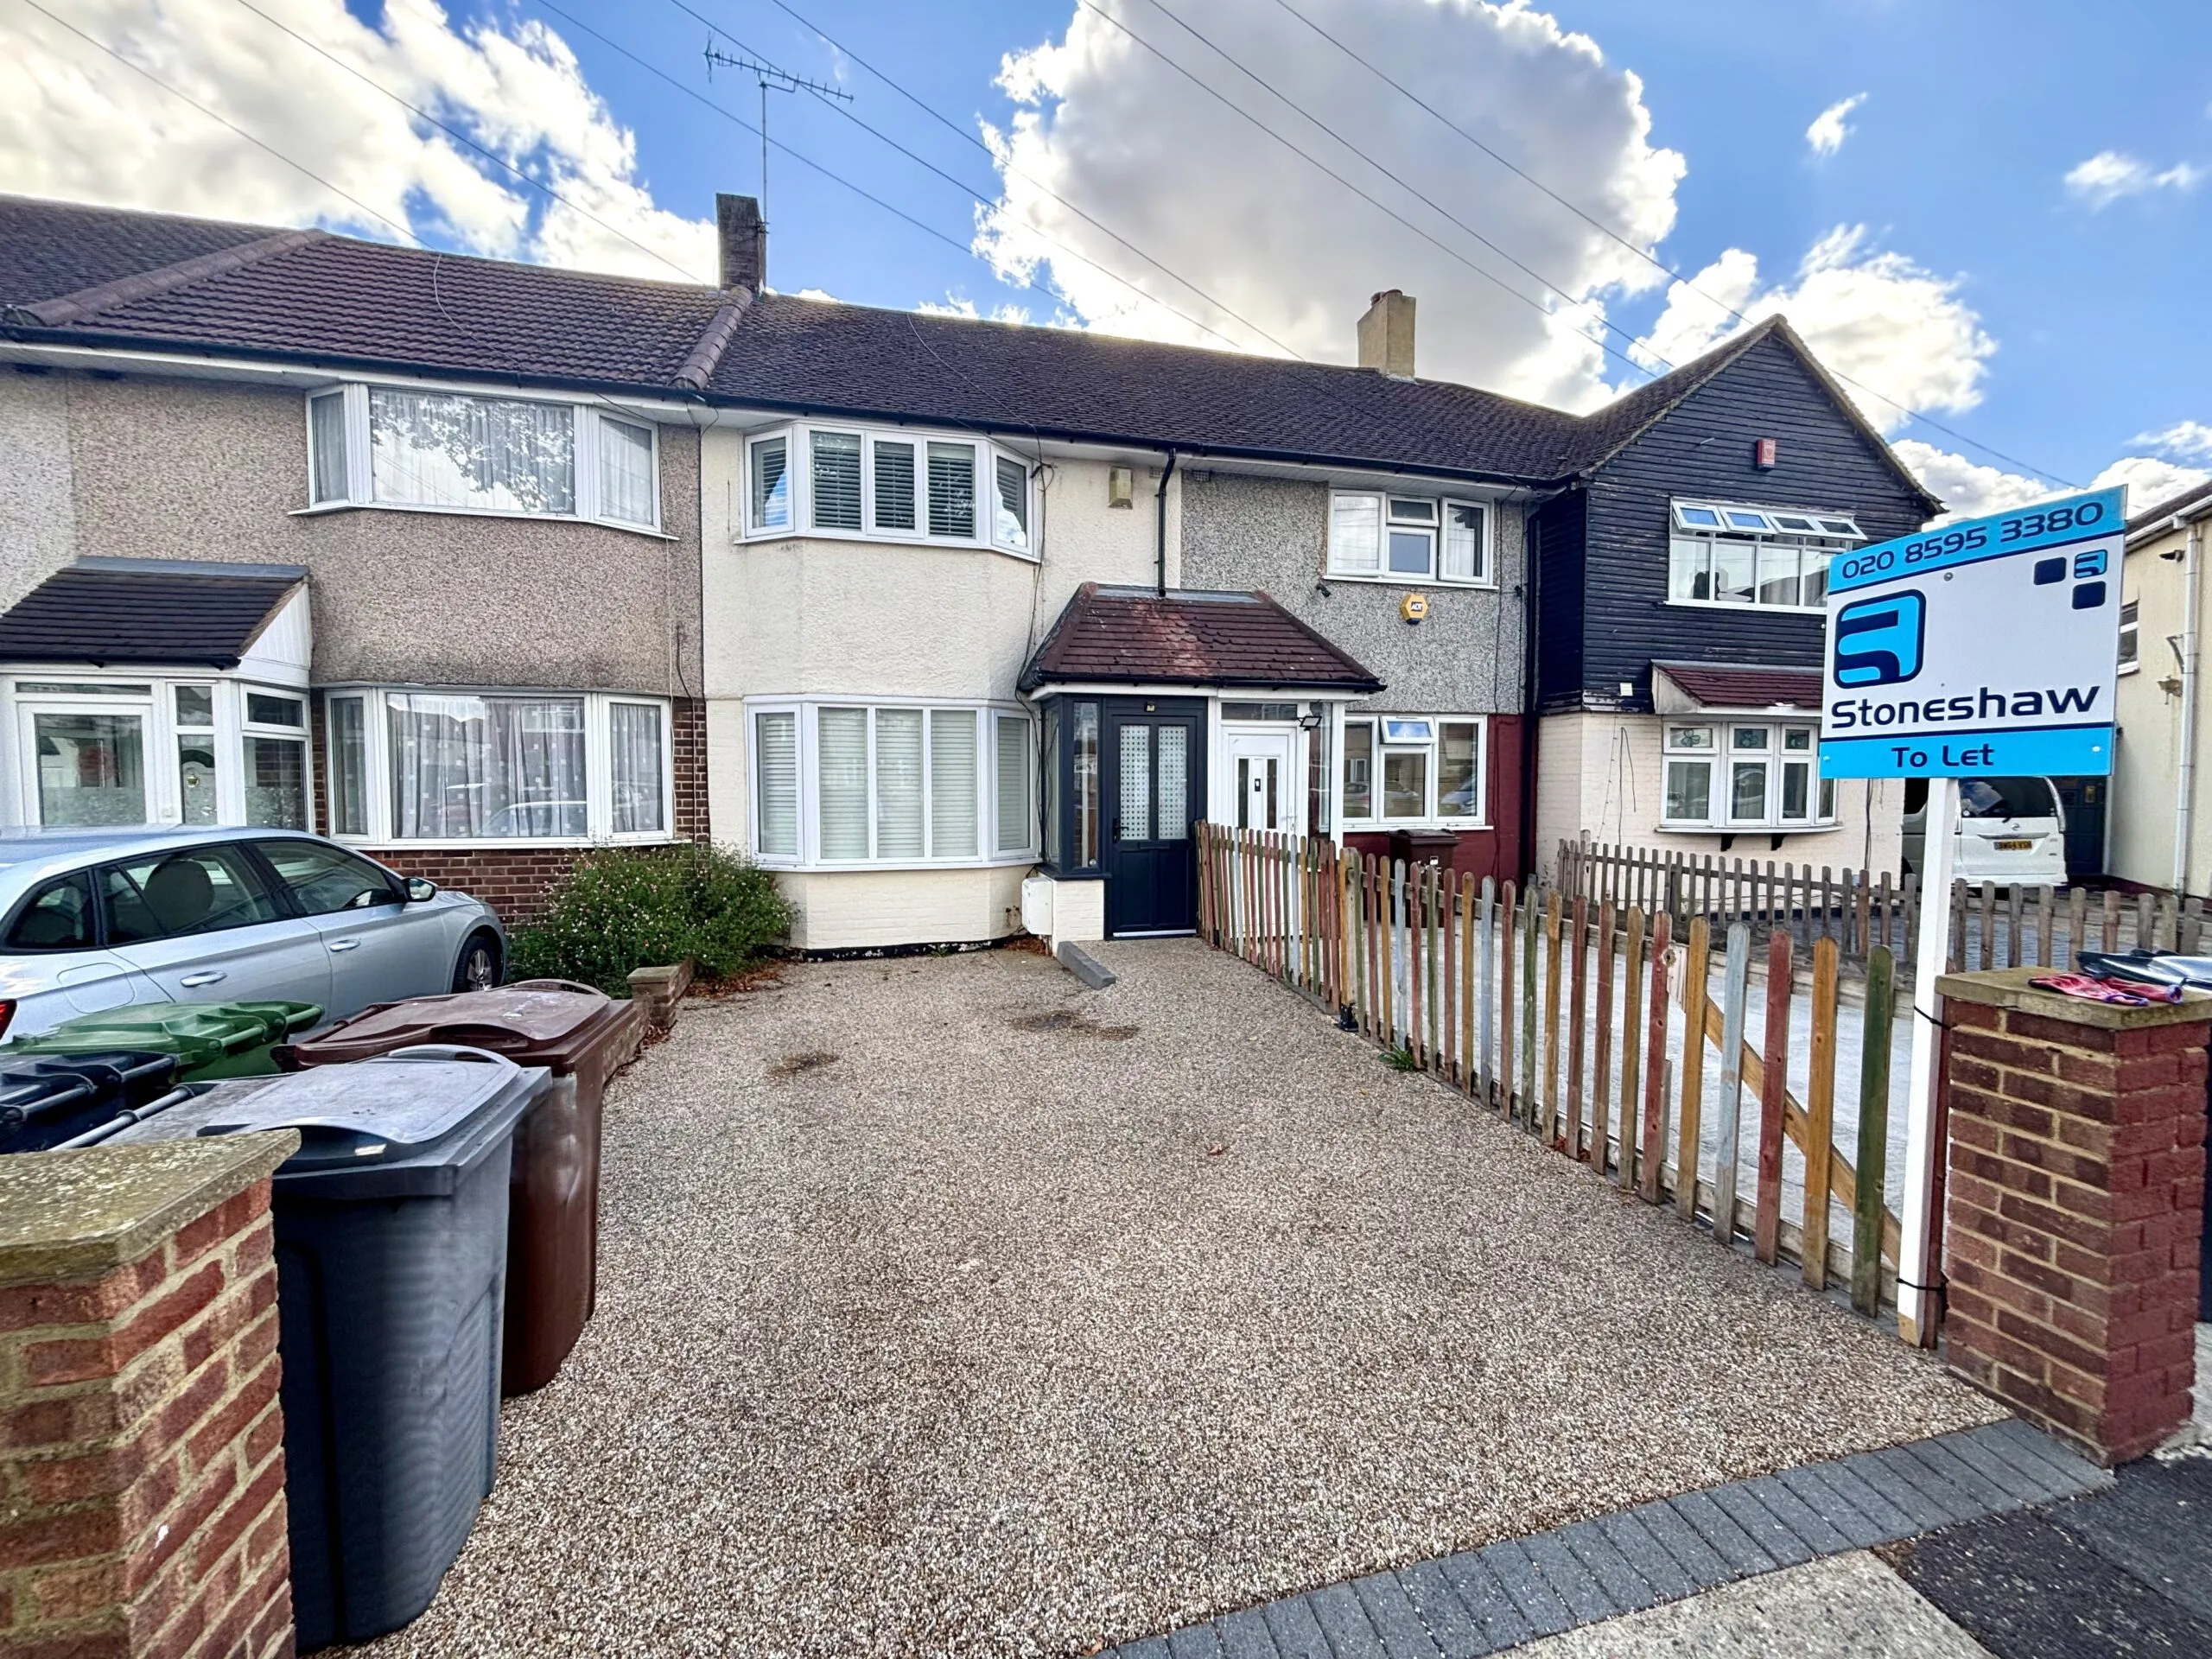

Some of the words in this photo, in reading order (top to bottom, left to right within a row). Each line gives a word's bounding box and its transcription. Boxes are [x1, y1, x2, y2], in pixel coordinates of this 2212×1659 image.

[1842, 550, 1895, 579] 020
[1904, 526, 1987, 563] 8595
[2000, 502, 2103, 543] 3380
[1831, 685, 2101, 728] Stoneshaw
[1891, 747, 1928, 768] To
[1942, 743, 1994, 767] Let
